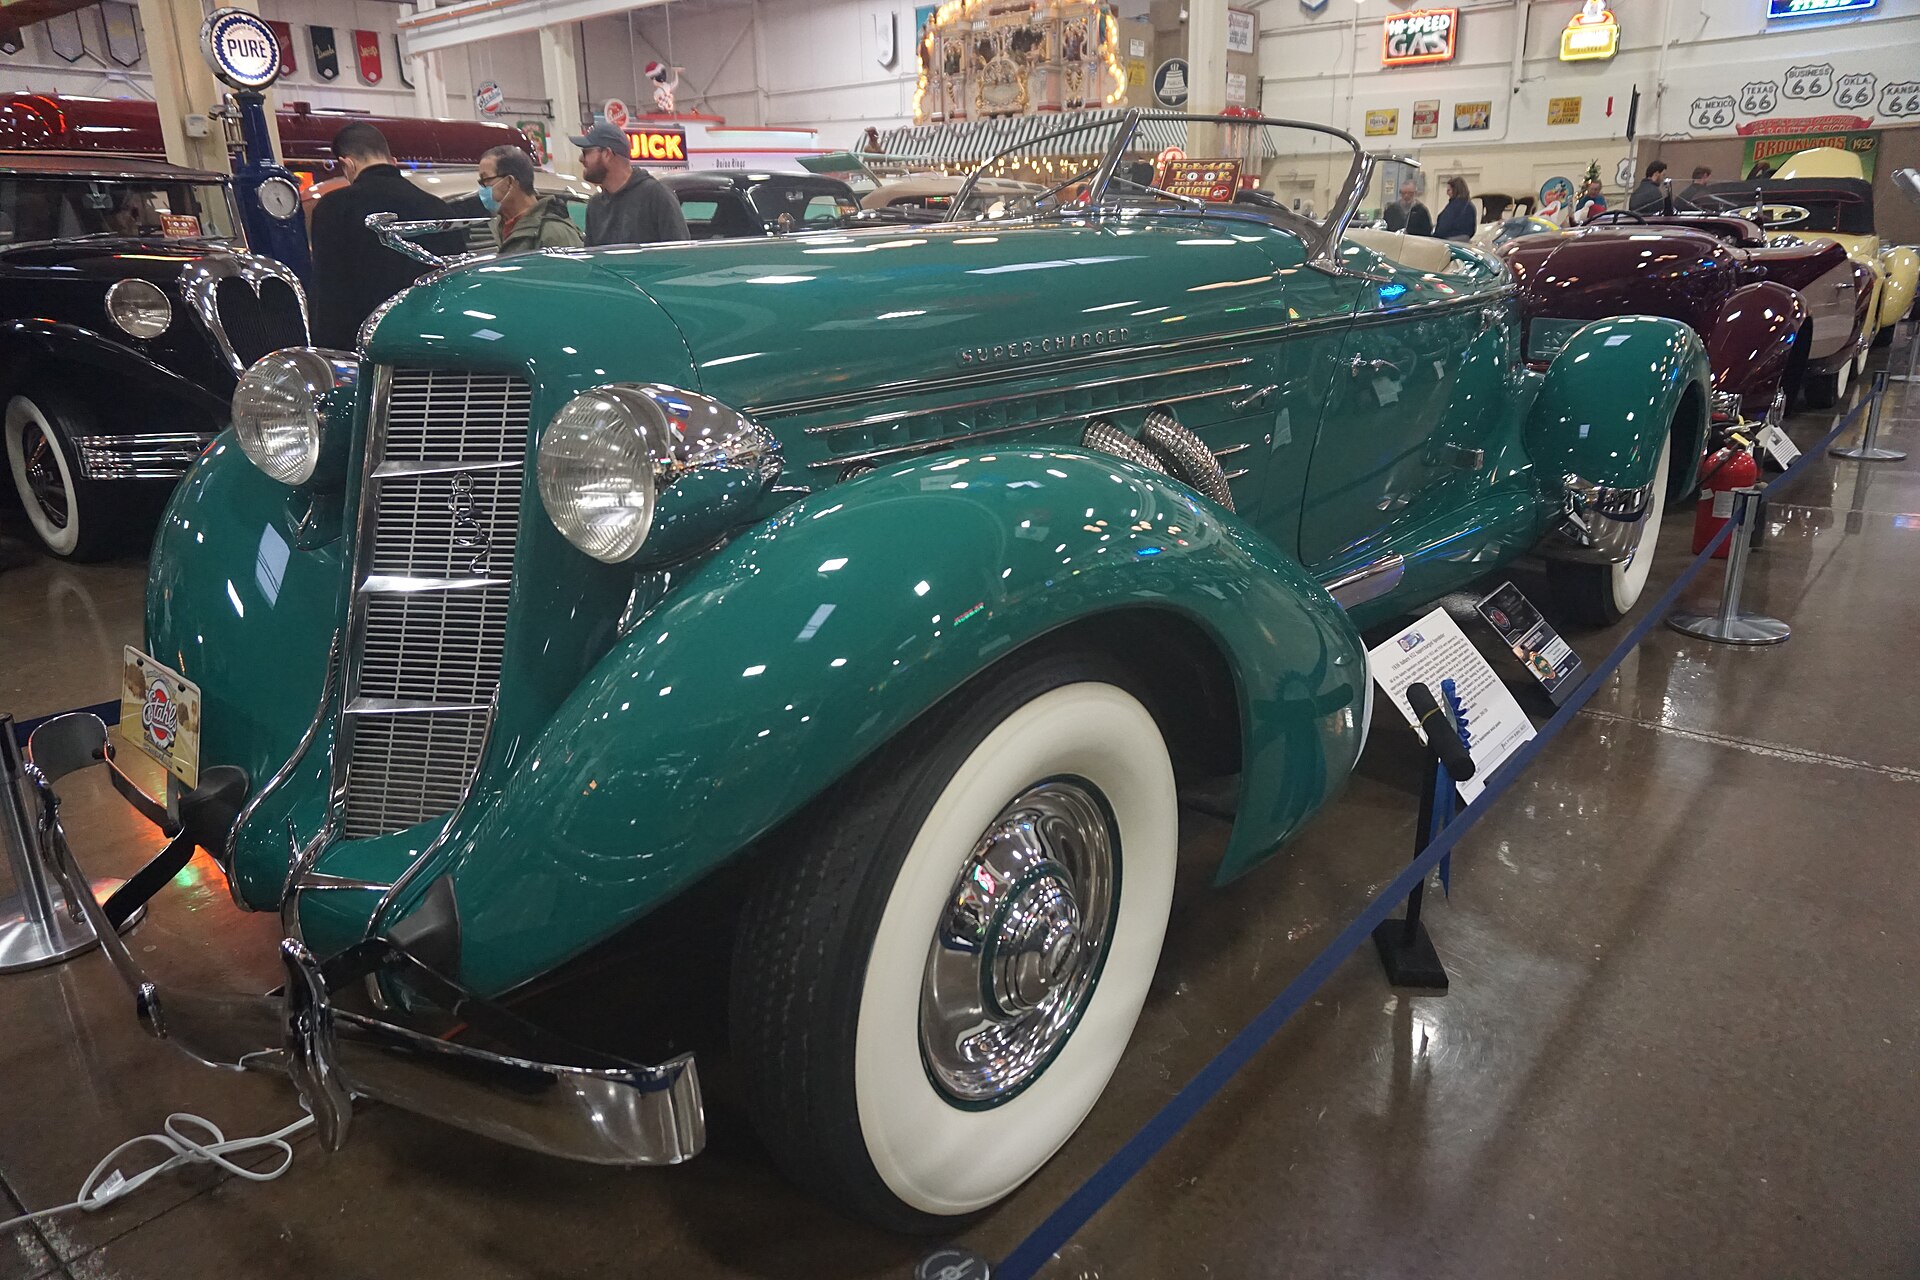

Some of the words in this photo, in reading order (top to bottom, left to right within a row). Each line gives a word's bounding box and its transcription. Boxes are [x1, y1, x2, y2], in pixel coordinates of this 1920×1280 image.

[227, 39, 268, 58] PURE
[360, 45, 378, 57] Jeep
[1388, 31, 1449, 56] GAS
[1788, 68, 1830, 78] BUSINESS
[1843, 76, 1872, 86] OKLA.
[1747, 86, 1774, 94] TEXAS
[1792, 78, 1823, 95] 66
[1886, 85, 1920, 95] KANSA
[1744, 95, 1771, 111] 66
[1839, 87, 1869, 104] 66
[1695, 101, 1703, 109] N.
[1705, 100, 1734, 109] MEXICO
[1888, 95, 1920, 113] 66
[1698, 109, 1725, 125] 66
[626, 132, 684, 160] UICK
[1753, 136, 1847, 160] BROOKLANDS
[1852, 138, 1873, 150] 1932
[1172, 162, 1235, 170] PLEASE
[1173, 171, 1232, 181] LOOK
[1166, 186, 1212, 197] TOUCH
[962, 327, 1129, 364] SUPER-CHARGED
